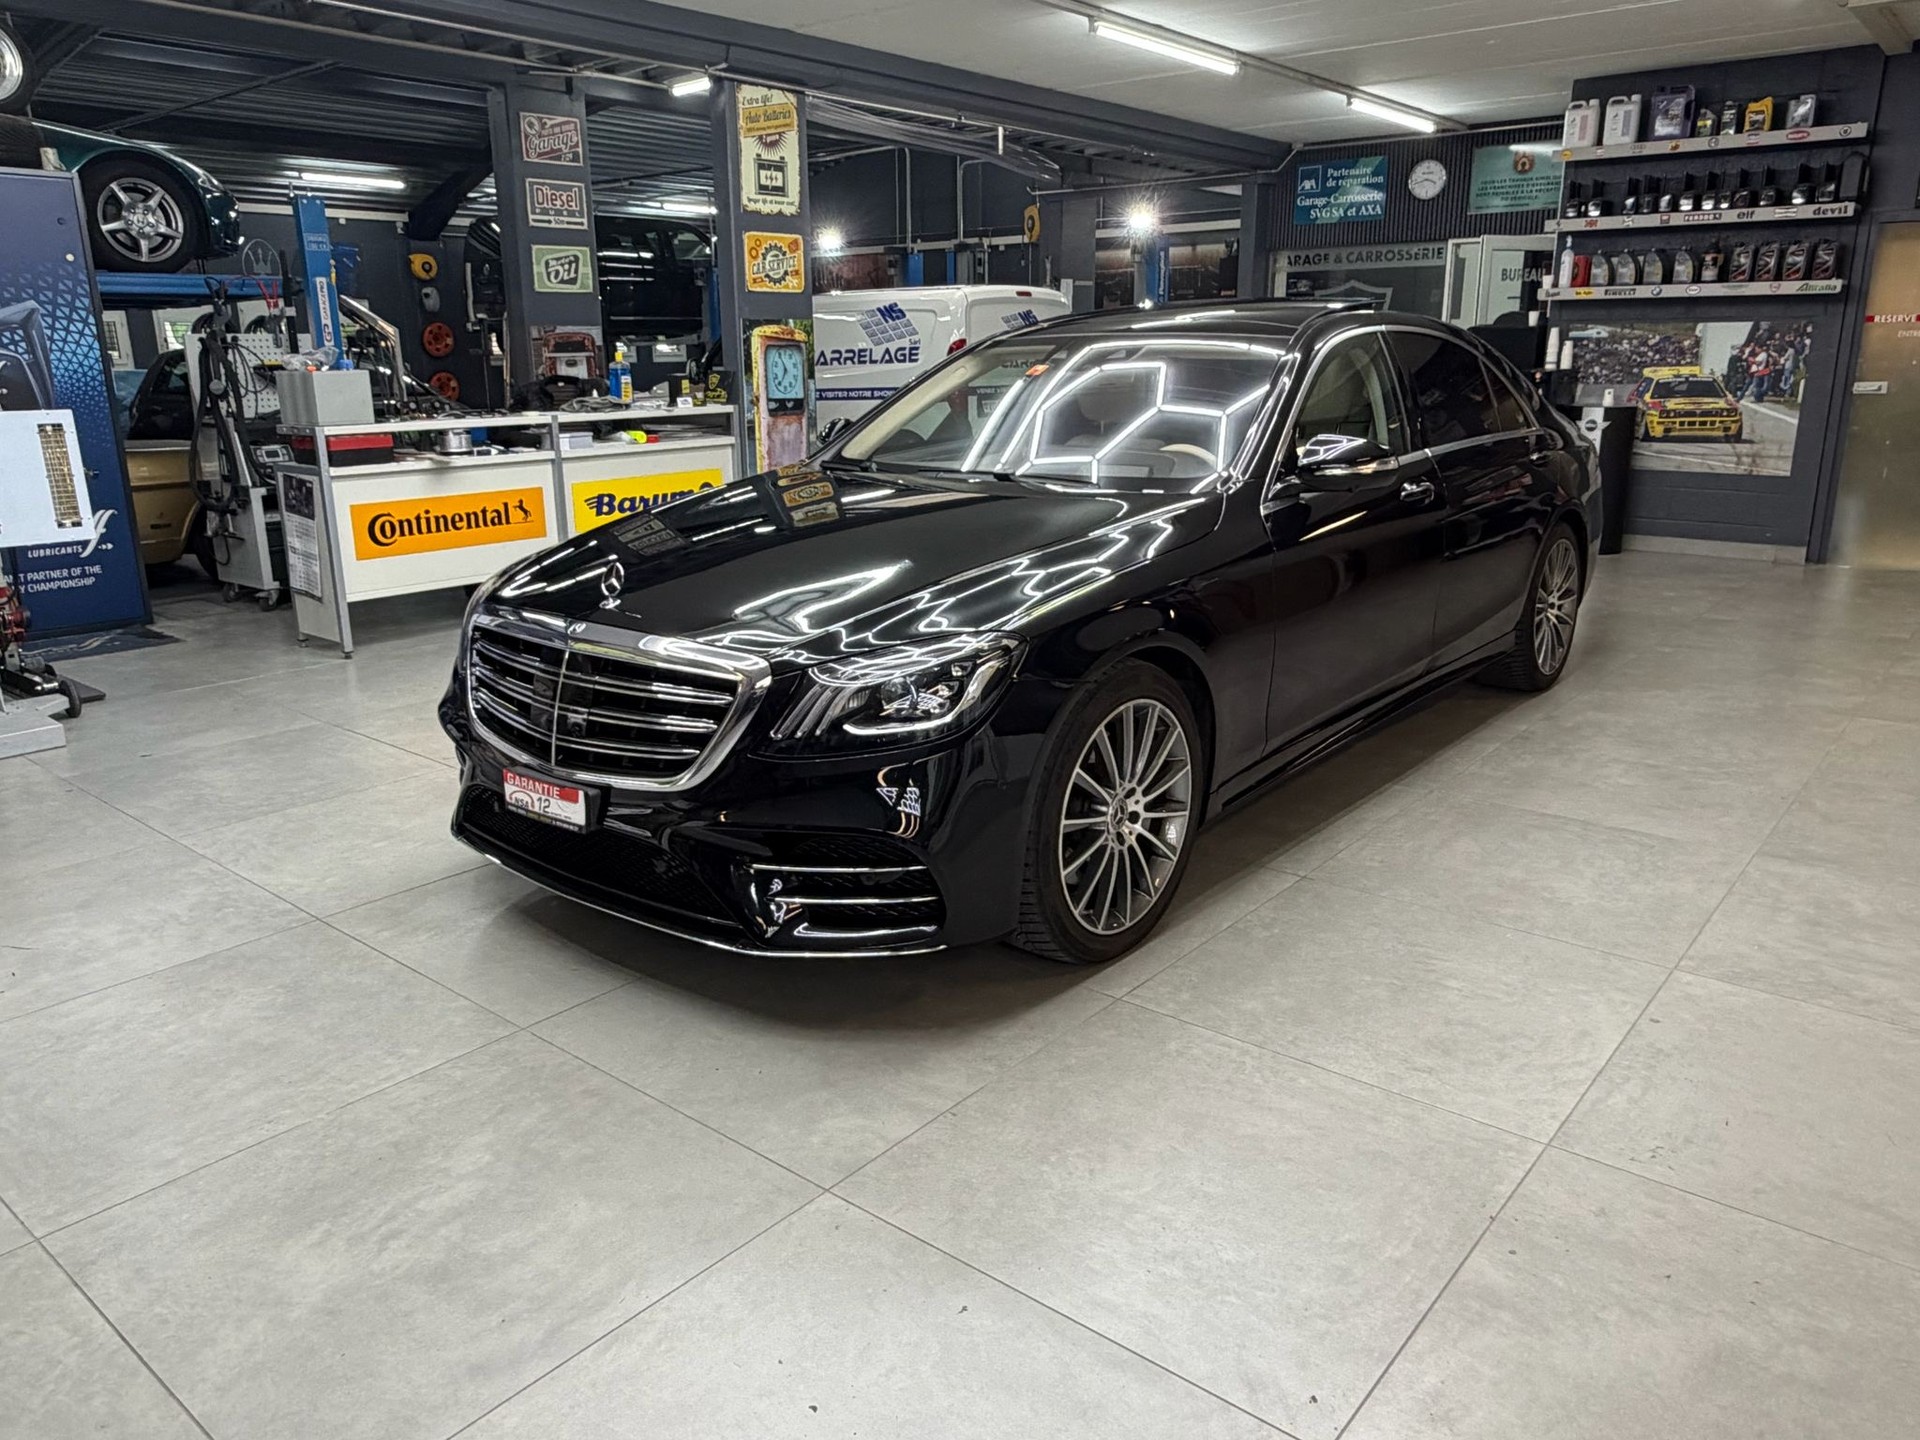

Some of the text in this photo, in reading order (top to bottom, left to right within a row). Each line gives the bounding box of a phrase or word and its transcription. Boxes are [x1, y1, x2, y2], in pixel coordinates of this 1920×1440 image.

[527, 130, 578, 158] Garage
[1327, 165, 1372, 177] Partenaire
[1326, 175, 1384, 188] de réparation
[534, 185, 580, 210] Diesel
[1297, 190, 1384, 208] Garage-Carrosserie
[1309, 203, 1382, 219] SVG SA et AXA
[1736, 210, 1755, 220] elf
[1812, 205, 1849, 216] devil
[1333, 253, 1343, 265] &
[1346, 247, 1444, 264] CARROSSERIE
[547, 263, 577, 284] Oil
[752, 255, 798, 276] CAR SERVICE
[1501, 267, 1546, 282] BUREAU
[1604, 287, 1637, 297] PIRELLI
[876, 302, 907, 324] NS
[1018, 309, 1039, 327] NS
[814, 346, 920, 367] ARRELAGE
[821, 390, 848, 399] VISITER
[849, 390, 872, 399] NOTRE
[367, 501, 512, 547] Continental
[28, 545, 82, 558] LUBRICANTS
[28, 569, 69, 581] PARTNER
[70, 567, 83, 577] OF
[84, 563, 103, 575] THE
[27, 576, 96, 594] CHAMPIONSHIP
[506, 772, 561, 800] GARANTIE
[536, 796, 552, 815] 12
